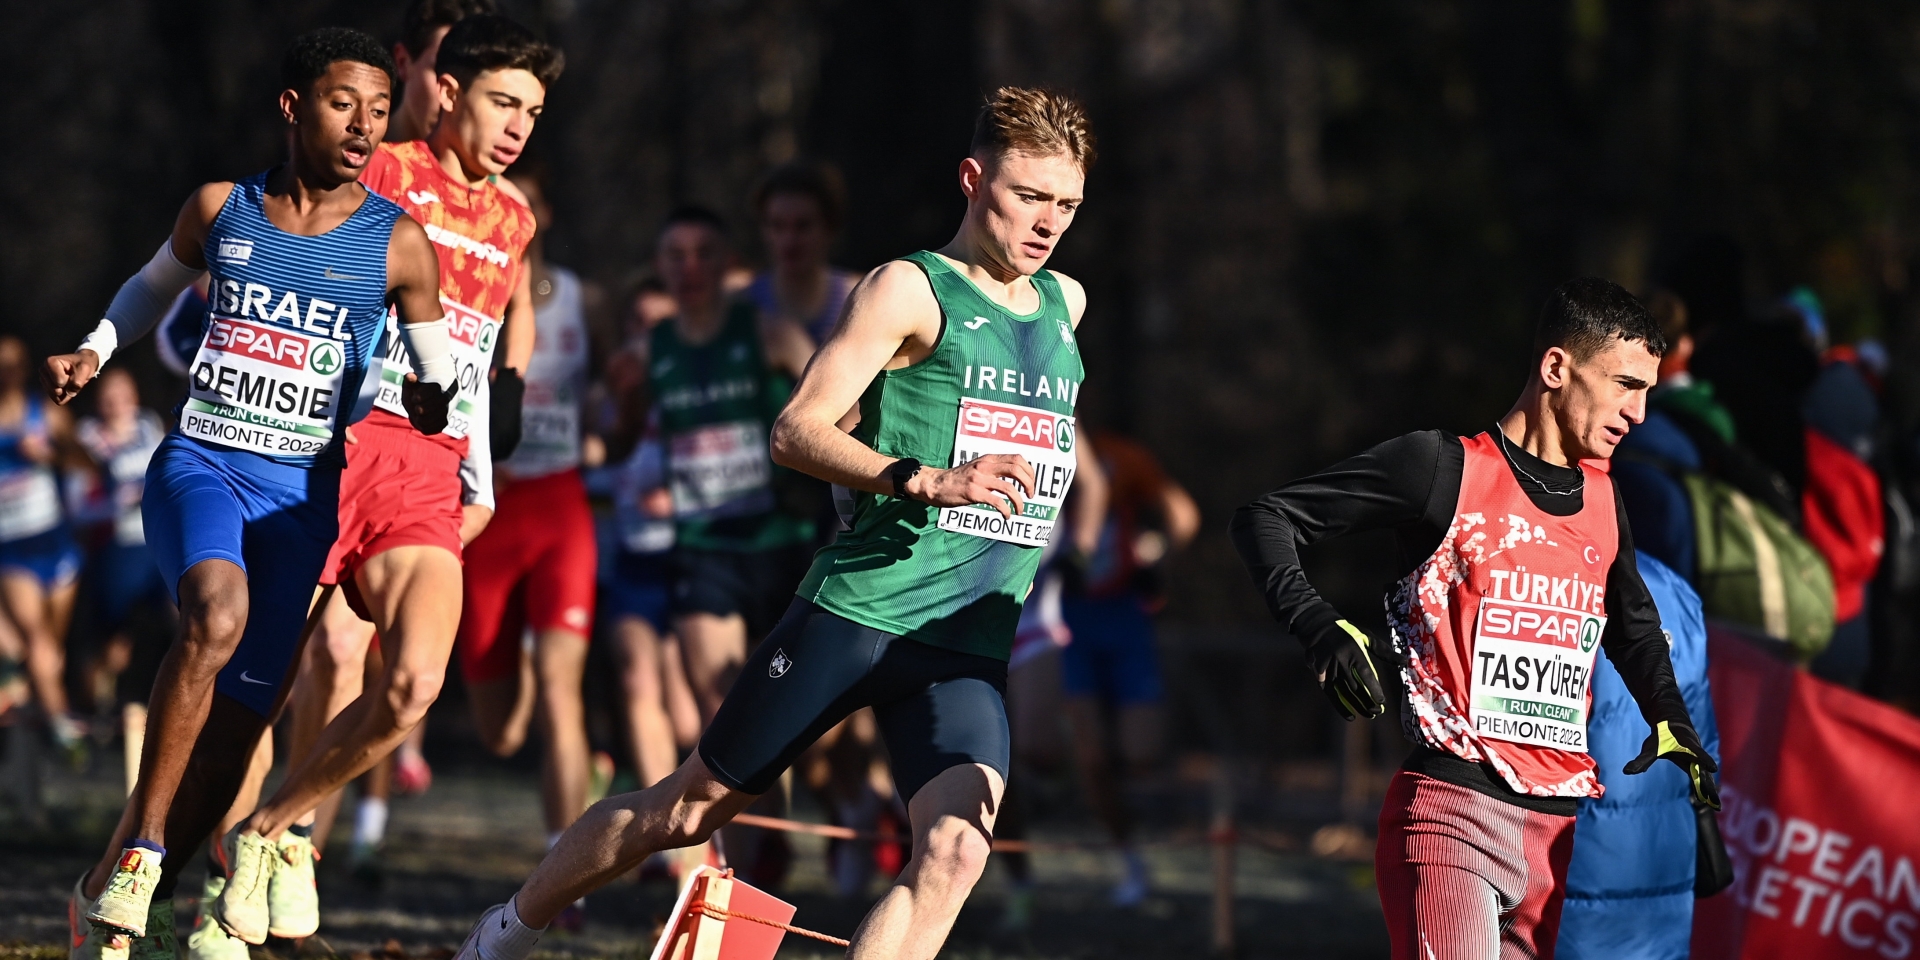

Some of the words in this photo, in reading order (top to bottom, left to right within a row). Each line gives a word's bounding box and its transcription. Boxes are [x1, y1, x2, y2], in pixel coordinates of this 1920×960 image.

[212, 279, 351, 341] ISRAEL
[209, 323, 305, 366] SPAR
[194, 362, 333, 421] DEMISIE
[219, 405, 248, 421] RUN
[964, 409, 1053, 445] SPAR
[186, 415, 274, 449] PIEMONTE
[278, 436, 324, 453] 2022
[947, 510, 1033, 540] PIEMONTE
[1490, 566, 1604, 615] TÜRKİYE
[1484, 608, 1579, 645] SPAR
[1478, 651, 1589, 701] TASYÜREK
[1510, 701, 1543, 715] RUN
[1476, 715, 1557, 747] PIEMONTE
[1559, 728, 1582, 747] 2022
